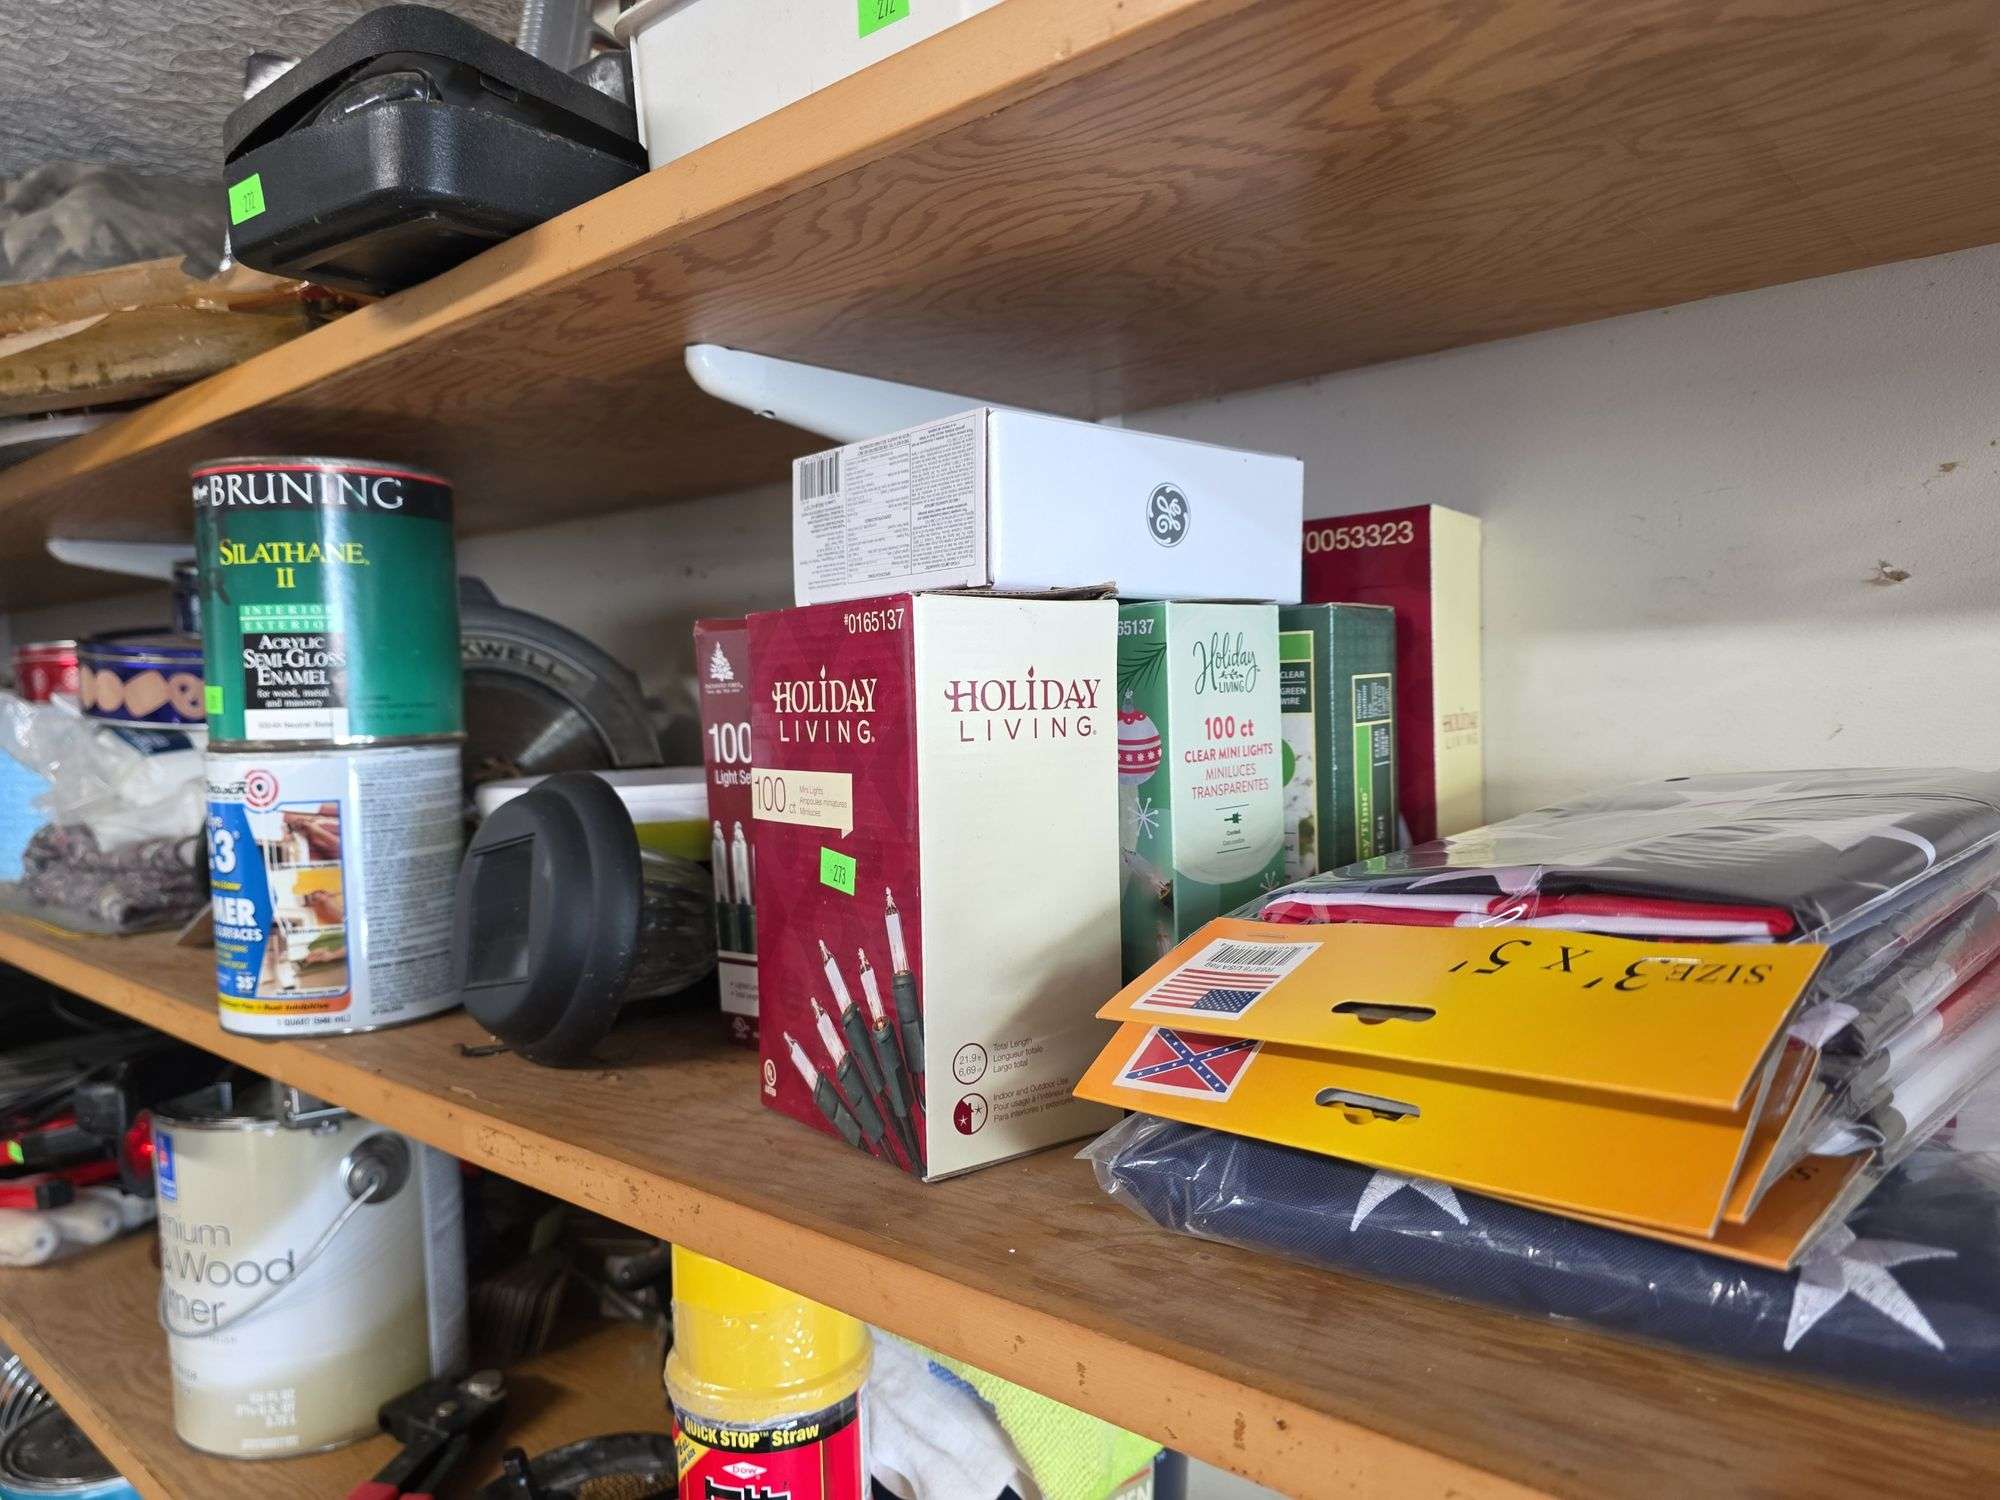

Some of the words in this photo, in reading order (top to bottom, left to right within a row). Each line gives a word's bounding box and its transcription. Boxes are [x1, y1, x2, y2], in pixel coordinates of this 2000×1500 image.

[209, 472, 404, 509] BRUNING
[246, 605, 335, 616] INTERIO
[244, 620, 336, 632] EXTERIO
[772, 665, 878, 713] HOLIDAY
[944, 665, 1101, 712] HOLIDAY
[1218, 681, 1244, 694] LIVING
[960, 715, 1092, 742] LIVING
[1204, 716, 1235, 740] 100
[1240, 719, 1254, 736] ct
[1184, 749, 1216, 763] CLEAR
[1218, 747, 1240, 760] MINI
[1243, 743, 1273, 758] LIGHTS
[1205, 763, 1257, 780] MINILUCES
[754, 776, 786, 812] 100
[1192, 778, 1270, 800] TRANSPARENTES
[174, 1247, 296, 1287] Wood
[684, 1416, 718, 1444] QUICK
[771, 1423, 821, 1448] Straw
